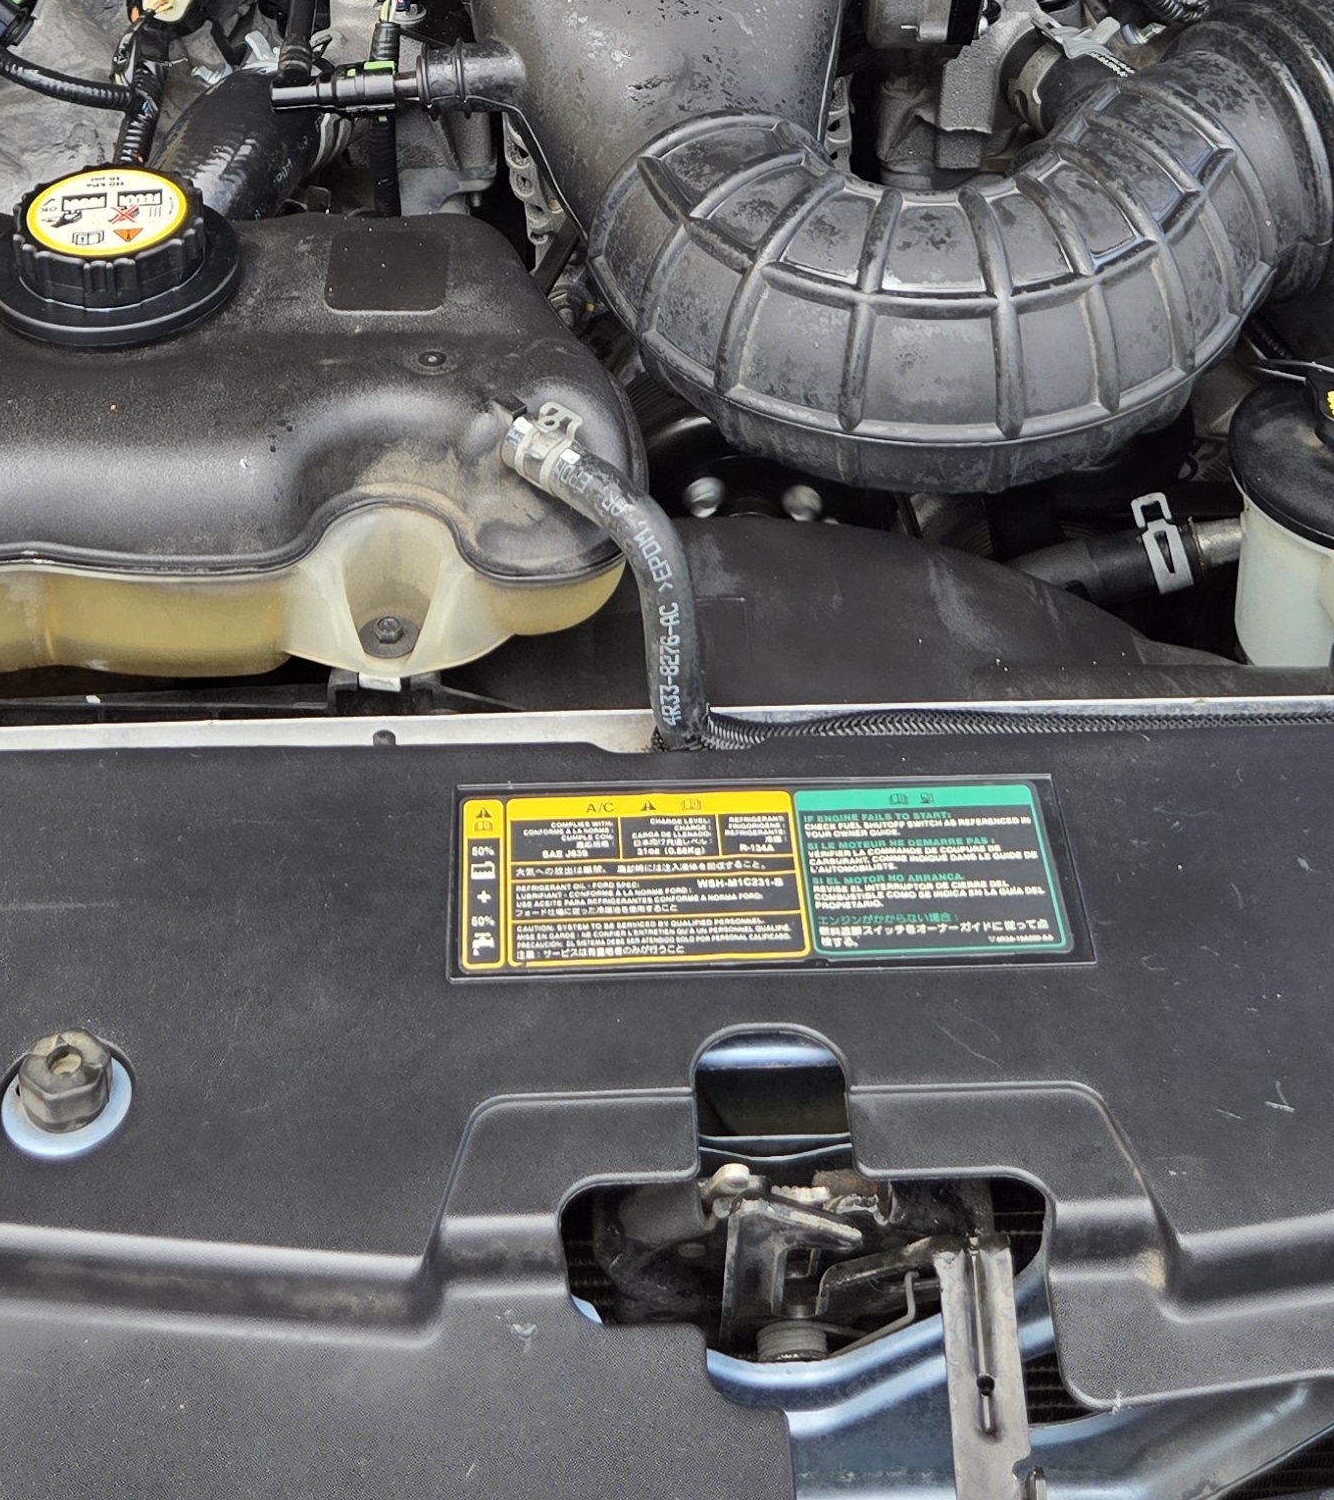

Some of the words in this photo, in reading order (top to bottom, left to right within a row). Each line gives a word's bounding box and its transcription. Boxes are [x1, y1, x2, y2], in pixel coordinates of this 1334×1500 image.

[658, 602, 682, 727] 4R33-8276-AC
[586, 802, 615, 813] A/C
[804, 822, 837, 830] CHECK
[838, 821, 863, 829] FUEL
[863, 820, 905, 829] SHUTOFF
[906, 819, 943, 828] SWITCH
[944, 819, 957, 827] AS
[957, 817, 1019, 826] REFERENCED
[817, 814, 858, 822] ENGINE
[861, 813, 892, 821] FAILS
[894, 812, 910, 820] TO
[805, 830, 832, 838] YOUR
[833, 829, 868, 837] OWNER
[807, 841, 818, 850] SI
[822, 841, 836, 849] LE
[838, 839, 886, 849] MOTEUR
[889, 839, 904, 847] NE
[965, 837, 988, 845] PAS
[471, 845, 495, 857] 50%
[852, 849, 867, 857] LA
[867, 847, 922, 855] COMMANDE
[924, 846, 939, 854] DE
[939, 845, 986, 854] COUPURE
[987, 844, 1002, 852] DE
[871, 855, 908, 863] COMME
[949, 853, 978, 862] DANS
[978, 852, 992, 860] LE
[992, 851, 1023, 860] GUIDE
[1023, 850, 1039, 859] DE
[812, 877, 823, 885] SI
[826, 876, 841, 885] EL
[844, 875, 885, 884] MOTOR
[888, 874, 905, 882] NO
[813, 884, 848, 892] REVISE
[850, 884, 864, 892] EL
[864, 881, 934, 891] INTERRUPTOR
[935, 881, 950, 890] DE
[988, 879, 1010, 888] DEL
[813, 891, 885, 901] COMBUSTIBLE
[886, 890, 917, 899] COMO
[918, 890, 932, 899] SE
[933, 888, 968, 898] INDICA
[968, 888, 984, 897] EN
[984, 887, 998, 896] LA
[471, 915, 495, 927] 50%
